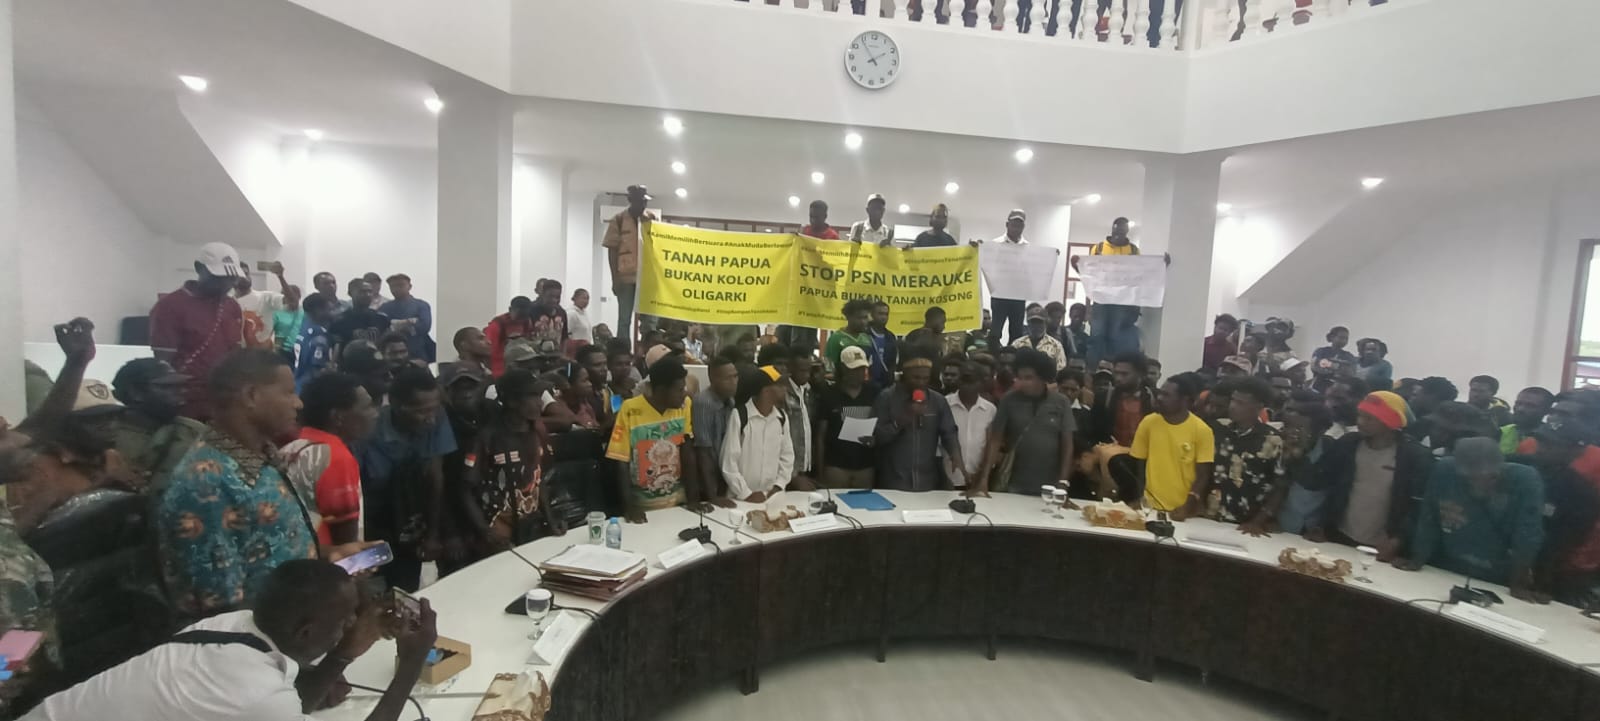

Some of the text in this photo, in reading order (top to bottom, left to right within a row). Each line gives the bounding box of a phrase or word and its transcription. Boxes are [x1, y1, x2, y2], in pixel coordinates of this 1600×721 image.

[662, 249, 771, 269] TANAH PAPUA
[664, 268, 770, 285] BUKAN KOLONI
[800, 264, 972, 289] STOP PSN MERAUKE
[682, 288, 747, 302] OLIGARKI
[800, 286, 973, 305] PAPUA BUKAN TANAH KOSONG
